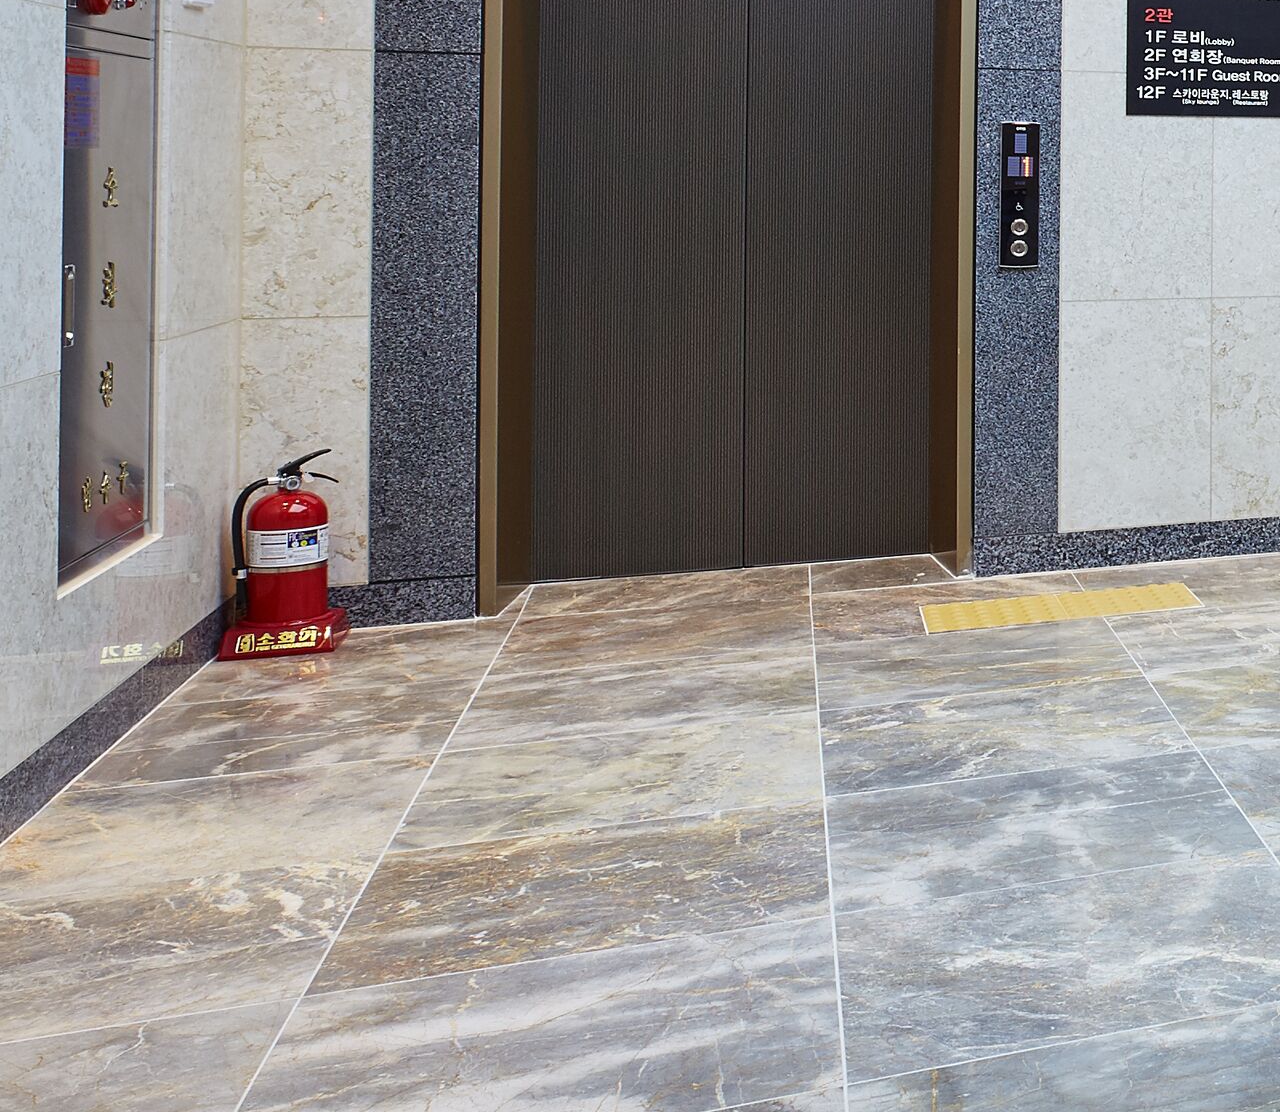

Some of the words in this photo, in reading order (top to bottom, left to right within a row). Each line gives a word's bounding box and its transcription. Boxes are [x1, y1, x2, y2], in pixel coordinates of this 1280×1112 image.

[1145, 8, 1174, 23] 2관
[1145, 30, 1167, 43] 1F
[1144, 48, 1167, 62] 2F
[1143, 67, 1208, 82] 3F~11F
[1212, 70, 1251, 83] Guest
[1136, 85, 1166, 99] 12F
